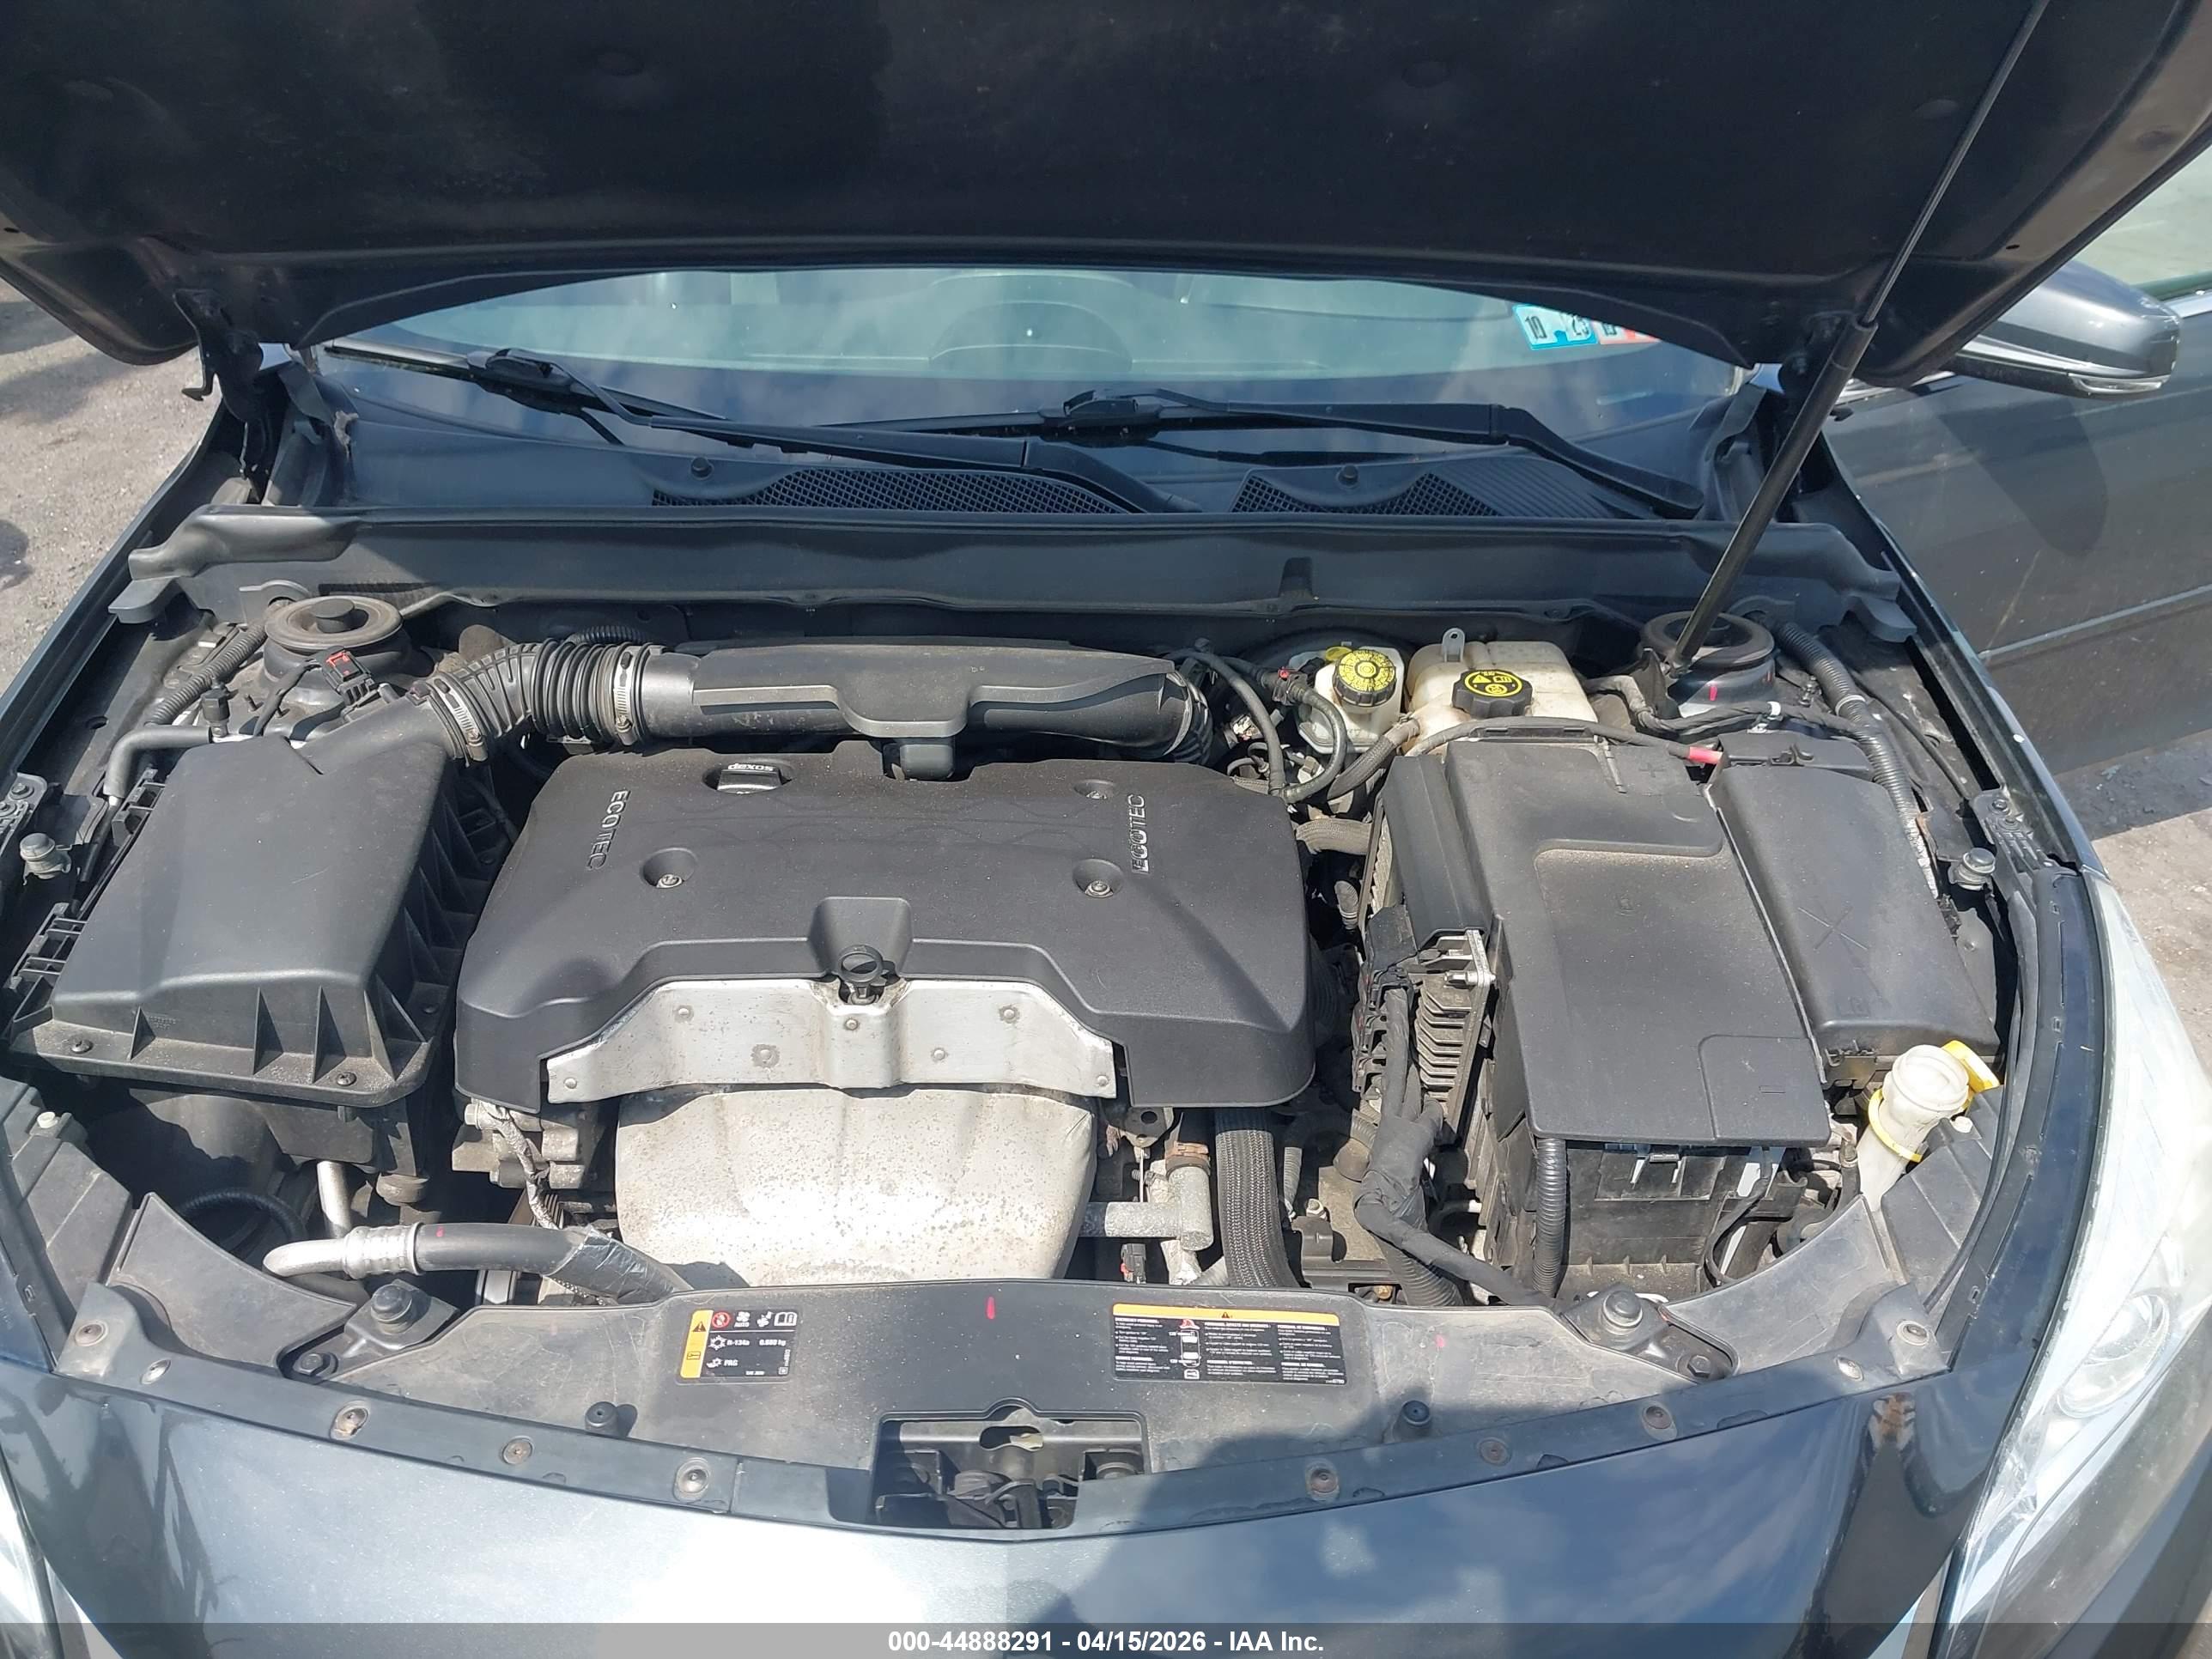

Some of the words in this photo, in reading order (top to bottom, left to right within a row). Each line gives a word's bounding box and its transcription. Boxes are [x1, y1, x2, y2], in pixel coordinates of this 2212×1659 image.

[1524, 315, 1547, 340] 10
[727, 763, 775, 772] dexos
[585, 788, 631, 871] ECOTEC
[1127, 793, 1151, 874] ECOTEC
